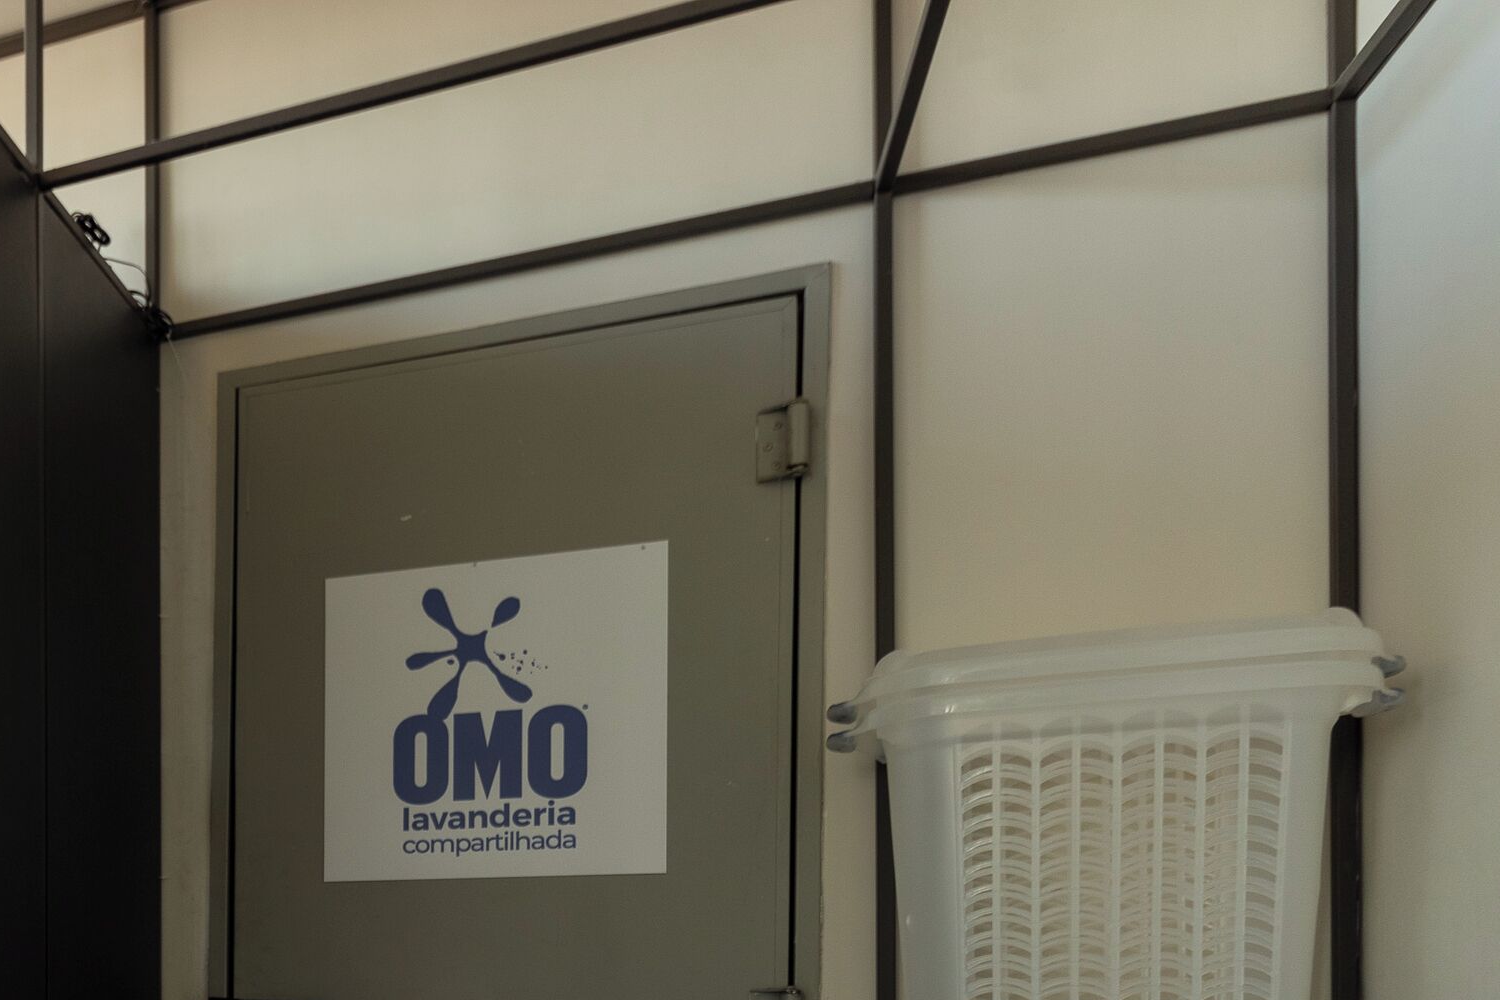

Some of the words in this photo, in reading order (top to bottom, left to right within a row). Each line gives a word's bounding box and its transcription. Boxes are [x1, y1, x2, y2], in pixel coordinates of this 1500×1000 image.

[393, 704, 588, 806] OMO
[403, 800, 577, 832] lavanderia
[402, 829, 577, 857] compartilhada
